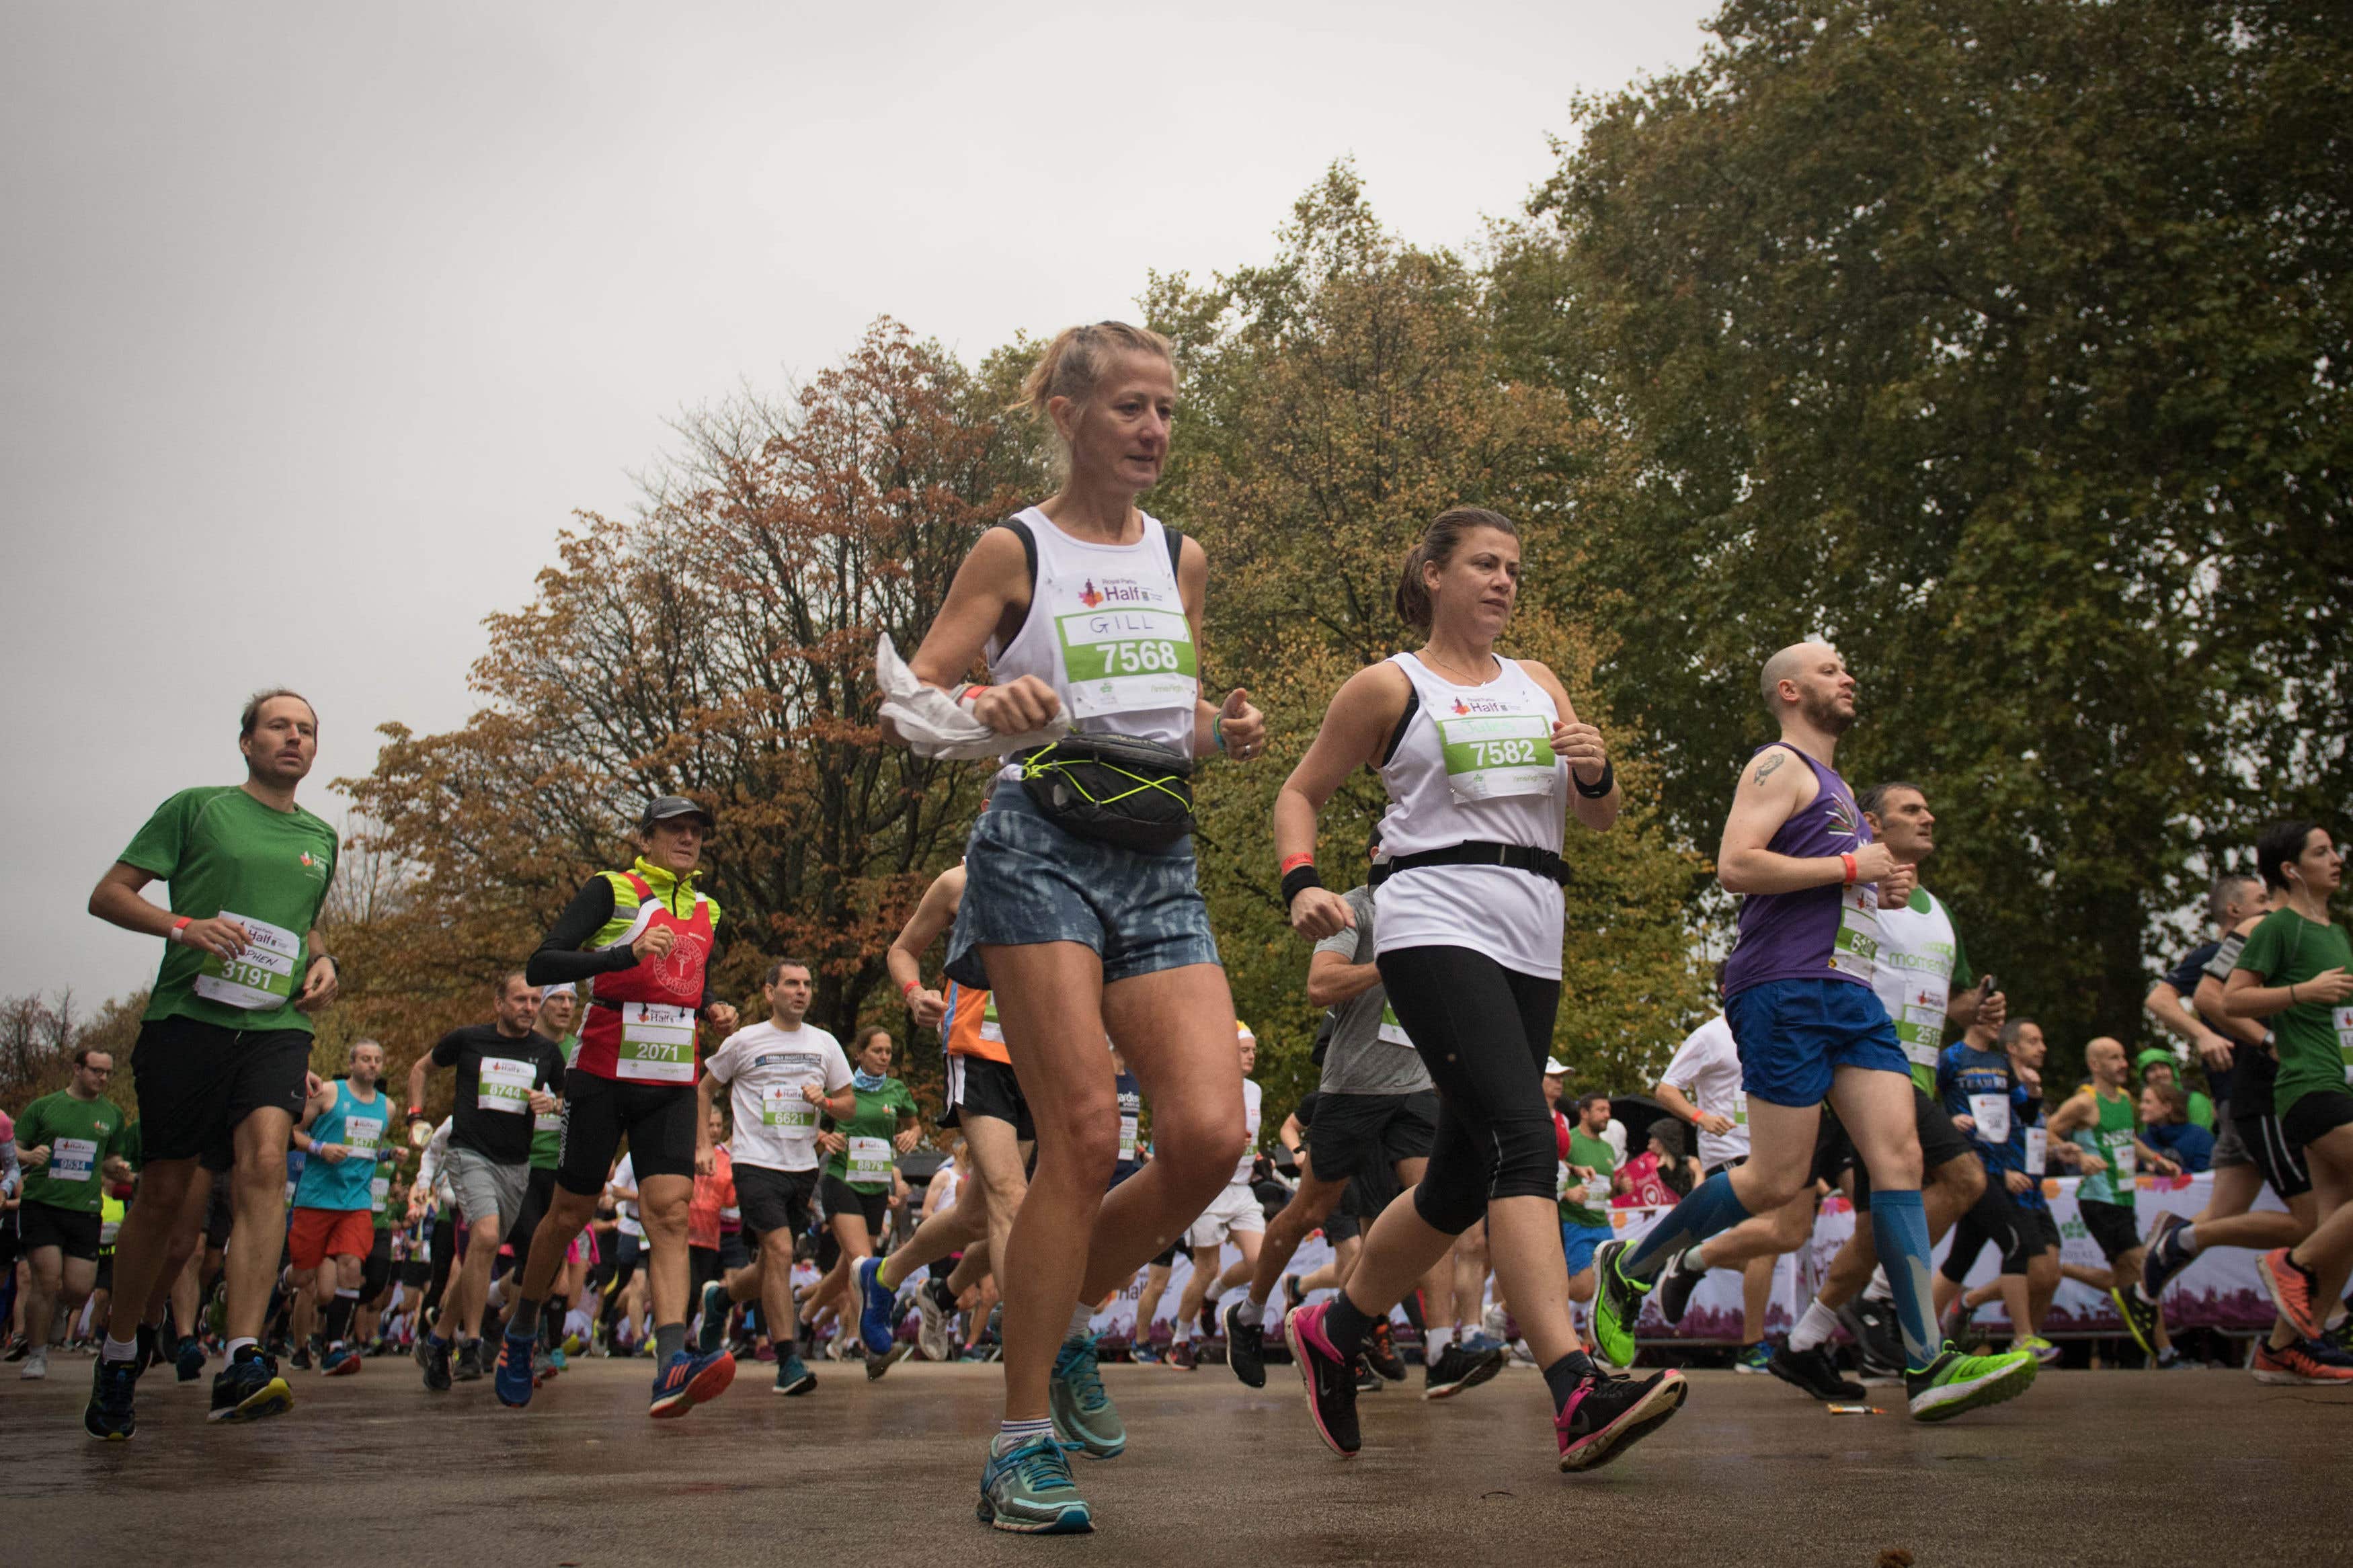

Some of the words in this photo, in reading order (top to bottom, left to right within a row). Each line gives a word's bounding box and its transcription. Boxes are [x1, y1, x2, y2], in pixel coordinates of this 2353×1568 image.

[1105, 586, 1140, 601] Half
[1090, 614, 1154, 633] GILL
[1096, 641, 1179, 673] 7568
[1470, 702, 1499, 712] Half
[1470, 739, 1536, 766] 7582
[221, 960, 272, 990] 3191
[650, 1013, 670, 1022] Half
[636, 1043, 678, 1061] 2071
[501, 1064, 516, 1073] Half
[489, 1083, 522, 1099] 8744
[774, 1113, 805, 1124] 6621
[857, 1161, 883, 1171] 8879
